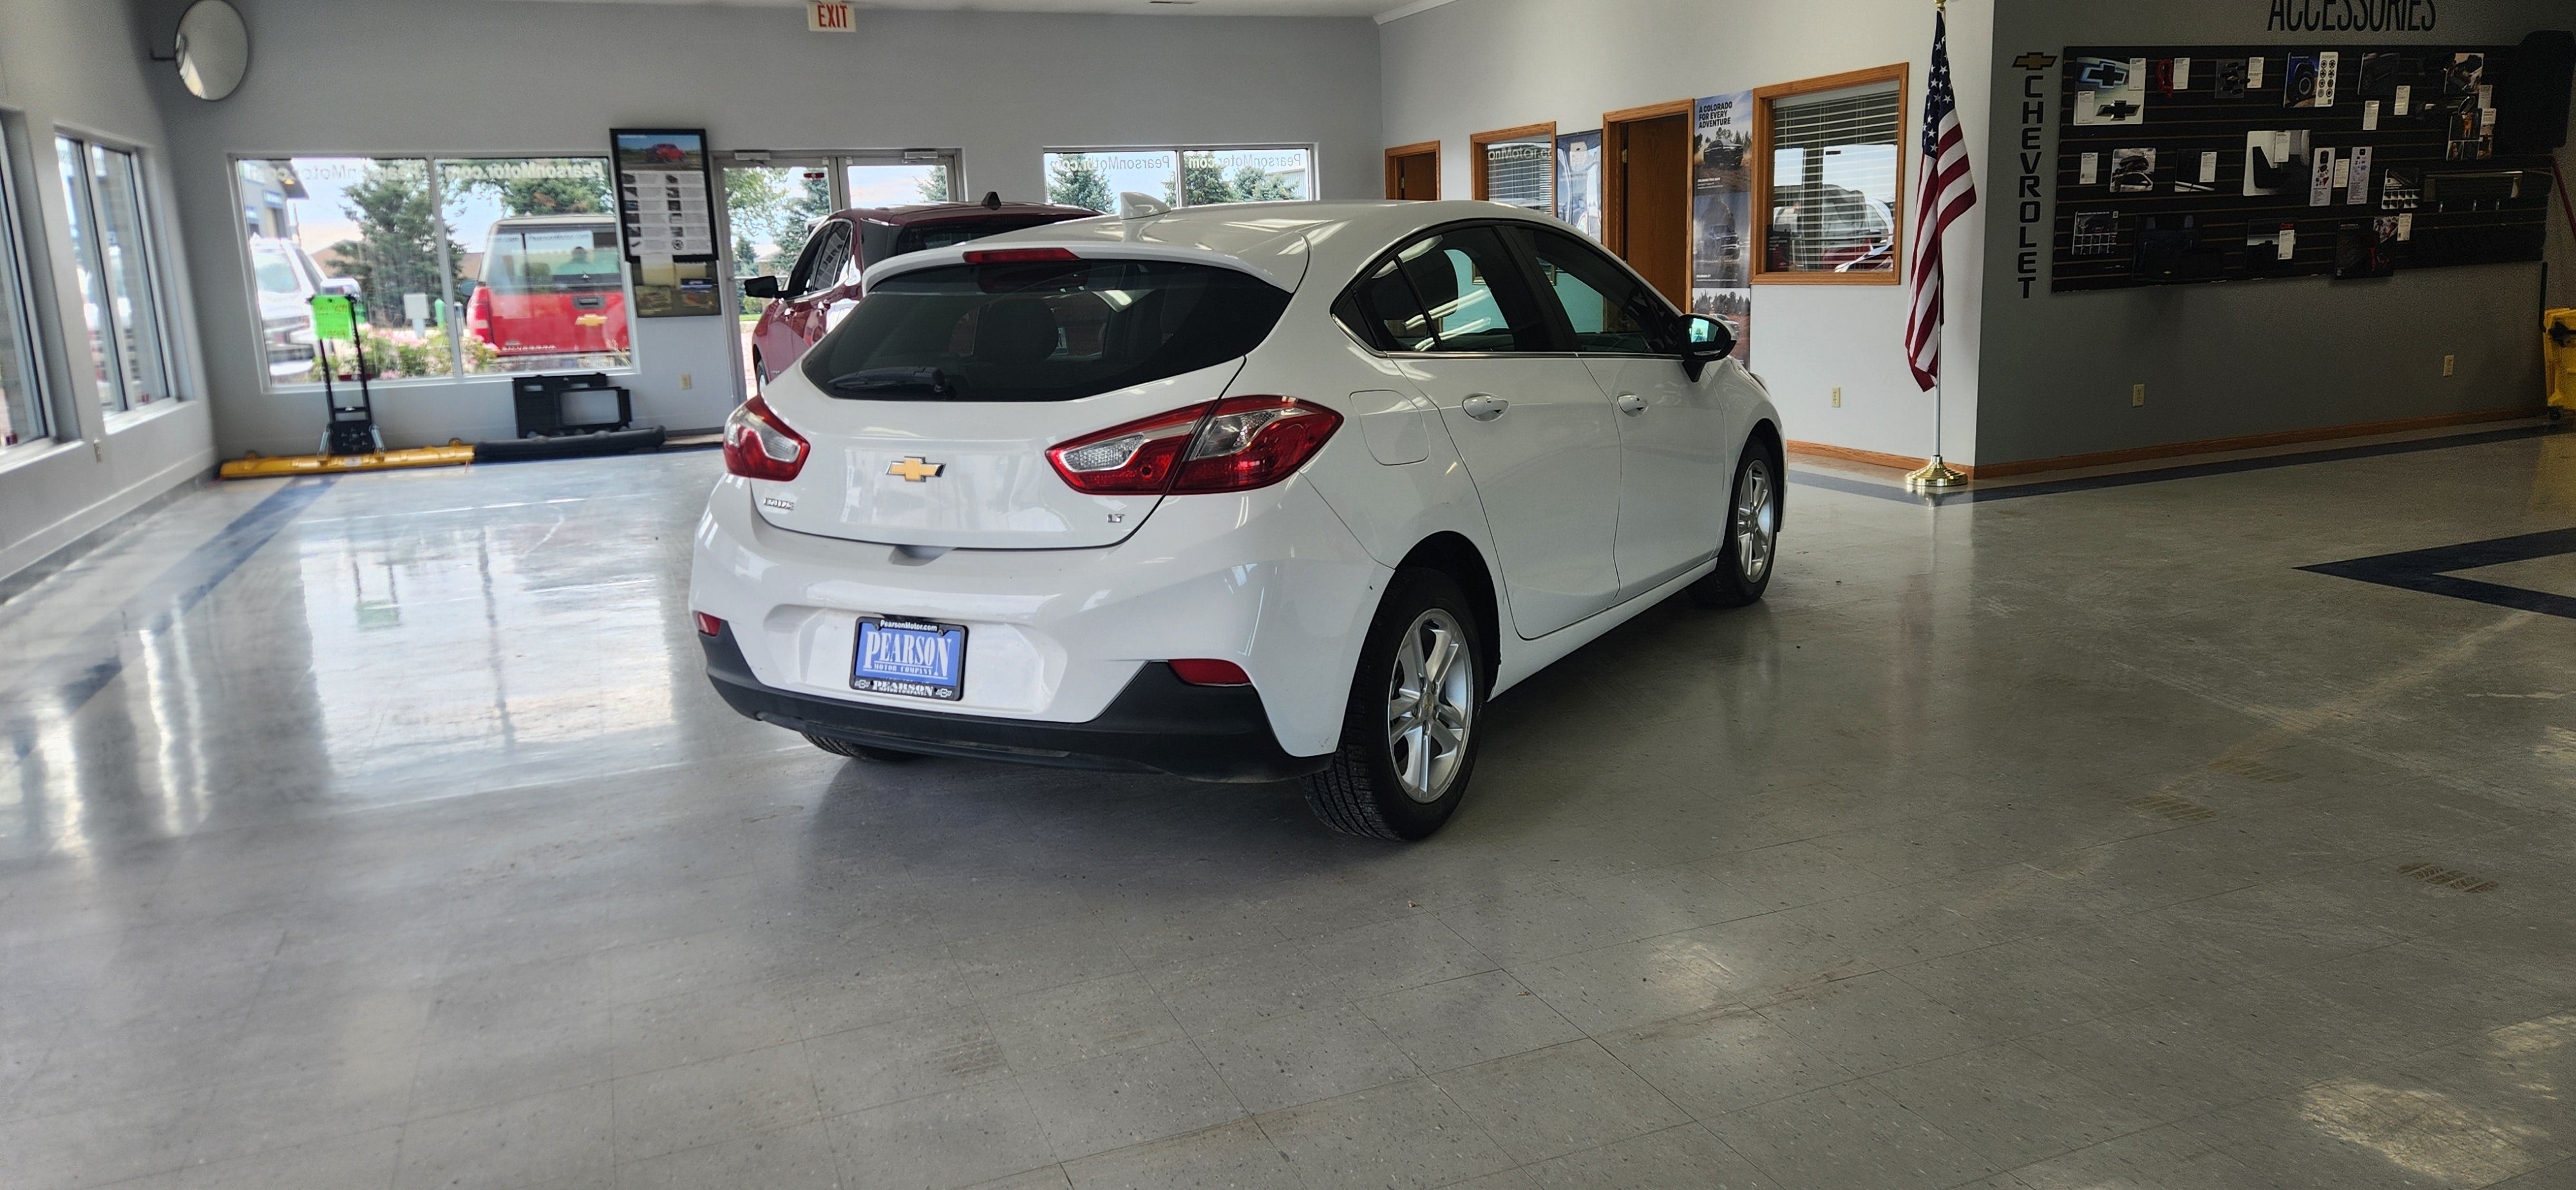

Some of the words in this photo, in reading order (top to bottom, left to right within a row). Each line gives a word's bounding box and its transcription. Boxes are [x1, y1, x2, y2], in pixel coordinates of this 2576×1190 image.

[817, 4, 848, 28] EXIT
[2267, 0, 2436, 31] ACCESSORIES
[1703, 101, 1732, 113] COLORADO
[1699, 113, 1709, 121] FOR
[1710, 109, 1728, 120] EVERY
[1698, 117, 1731, 129] ADVENTURE
[2018, 75, 2044, 299] CHEVROLET
[1107, 514, 1125, 523] LT
[880, 619, 938, 632] PearsonMotor.com
[863, 631, 952, 677] PEARSON
[874, 663, 897, 672] MOTOR
[901, 666, 933, 675] COMPANY
[872, 680, 934, 696] PEARSON
